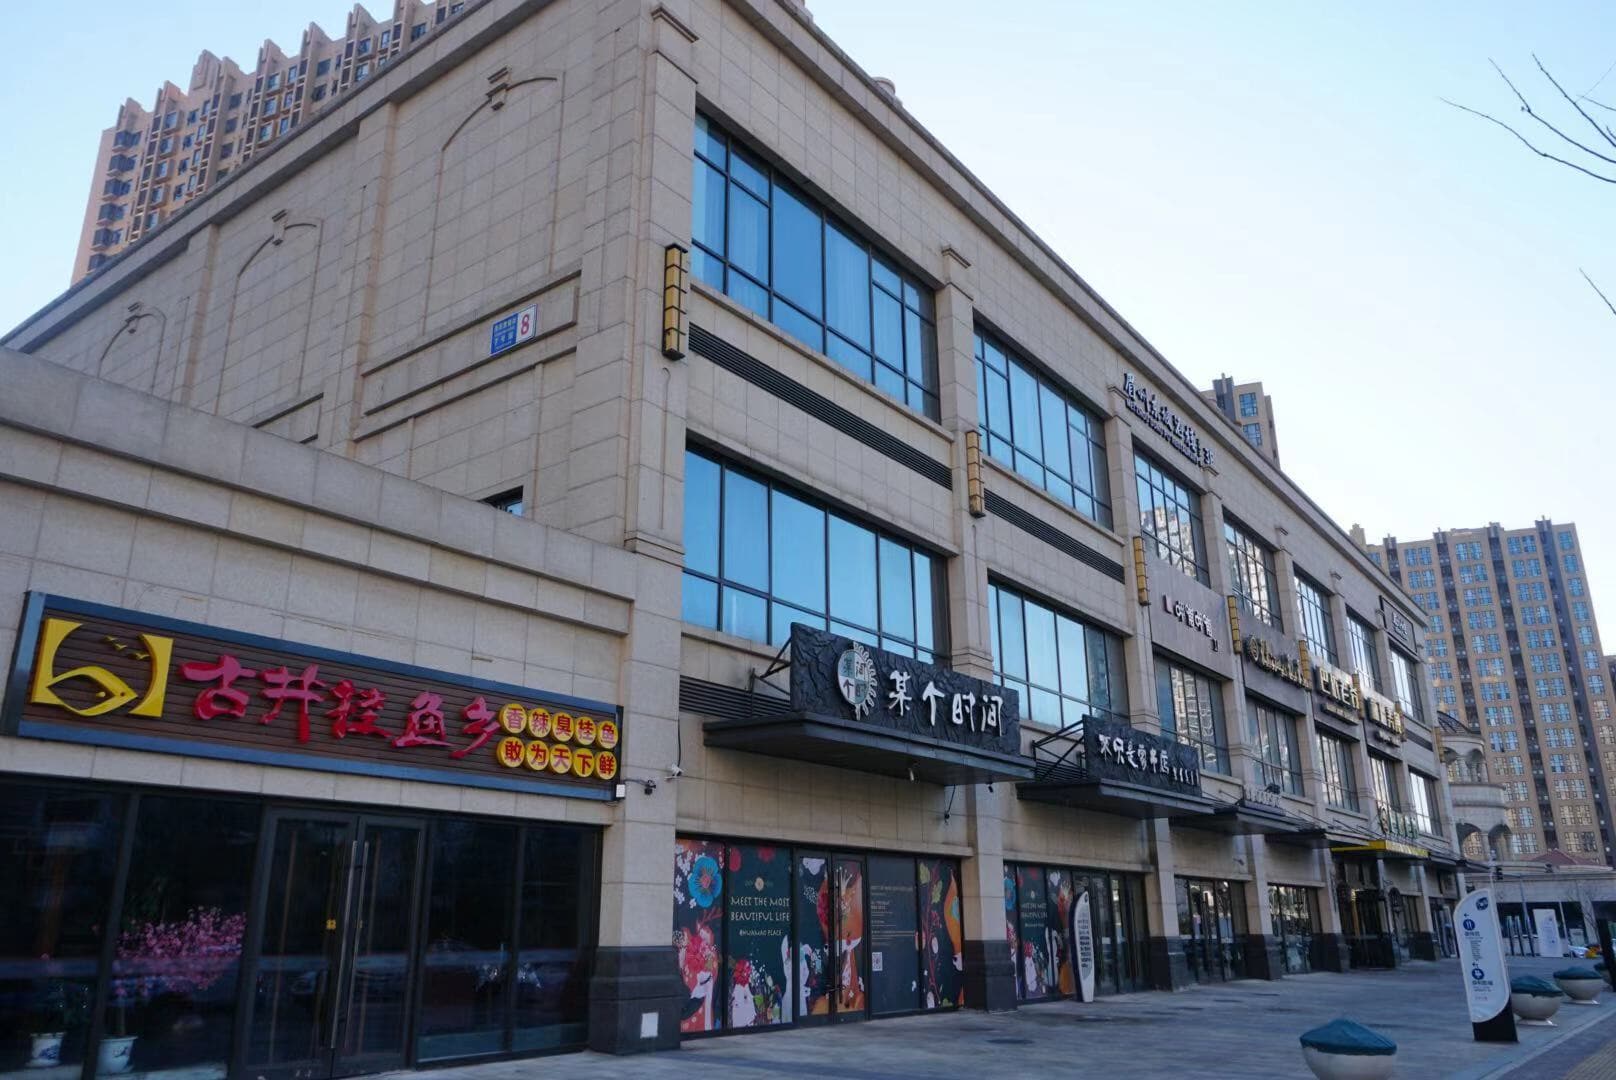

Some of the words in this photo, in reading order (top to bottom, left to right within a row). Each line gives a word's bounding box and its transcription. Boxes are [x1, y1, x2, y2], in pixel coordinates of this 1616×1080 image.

[520, 314, 530, 336] 8
[889, 670, 1003, 736] 某个时间
[501, 738, 616, 777] 敢为天下鲜
[730, 896, 752, 906] MEET
[753, 897, 768, 907] THE
[769, 897, 790, 907] MOST
[730, 911, 774, 921] BEAUTIFUL
[775, 912, 790, 921] LIFE
